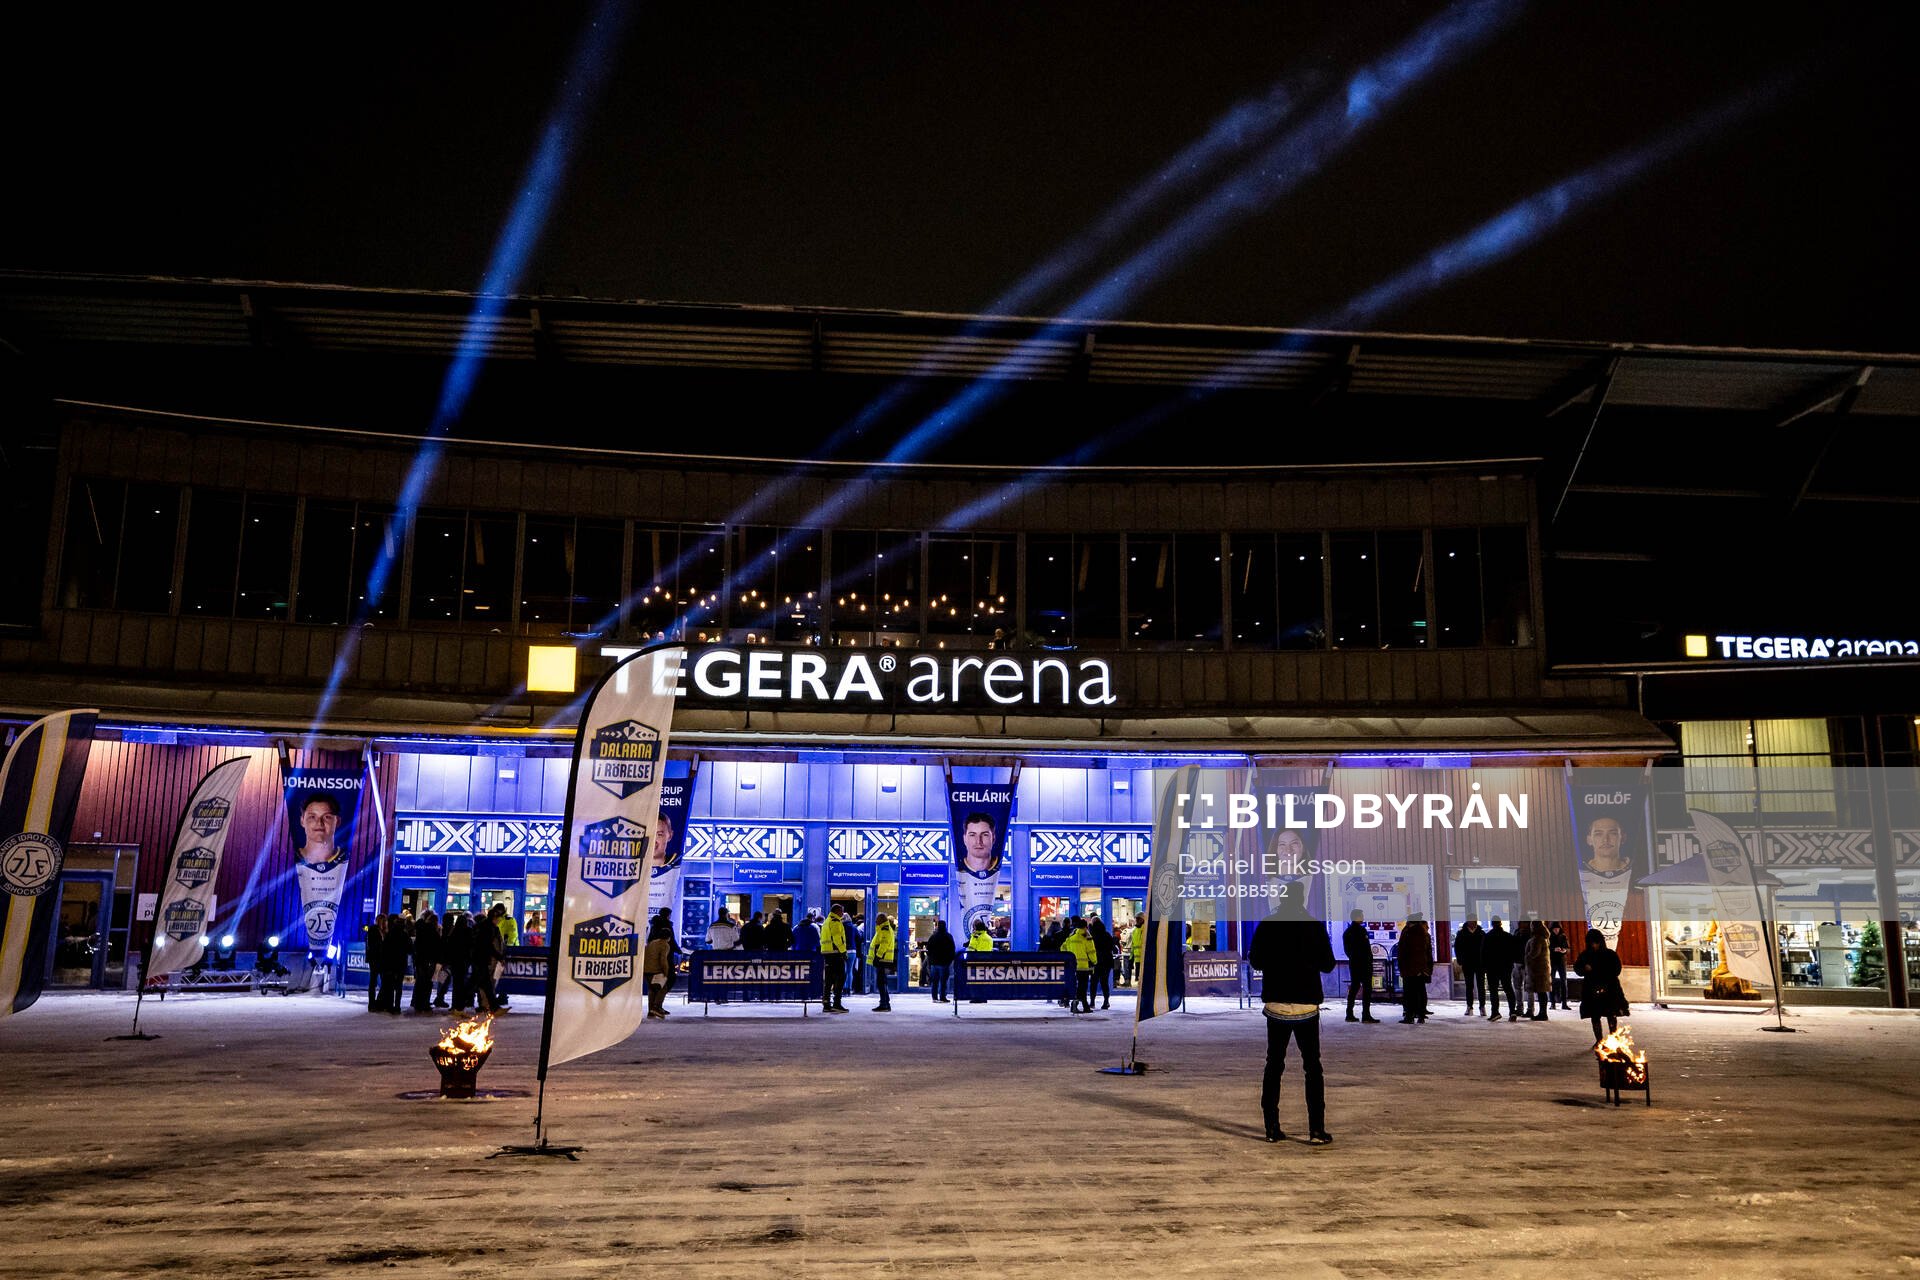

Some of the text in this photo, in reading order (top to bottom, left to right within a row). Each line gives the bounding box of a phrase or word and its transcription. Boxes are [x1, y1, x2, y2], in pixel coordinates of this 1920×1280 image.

[1715, 636, 1919, 658] TEGERA arena
[907, 656, 1117, 704] arena
[600, 742, 652, 759] DALARNA
[604, 762, 651, 778] RÖRELSE
[284, 776, 362, 790] JOHANSSON
[951, 789, 1011, 803] CEHLÁRIK
[1584, 792, 1632, 805] GIDLÖF
[588, 839, 642, 856] DALARNA
[594, 860, 638, 876] RÖRELSE
[579, 937, 629, 955] DALARNA
[536, 962, 547, 976] IF
[585, 959, 628, 976] RÖRELSE
[703, 965, 810, 980] LEKSANDS IF
[966, 966, 1065, 980] LEKSANDS IF
[1189, 964, 1238, 977] LEKSANDS IF
